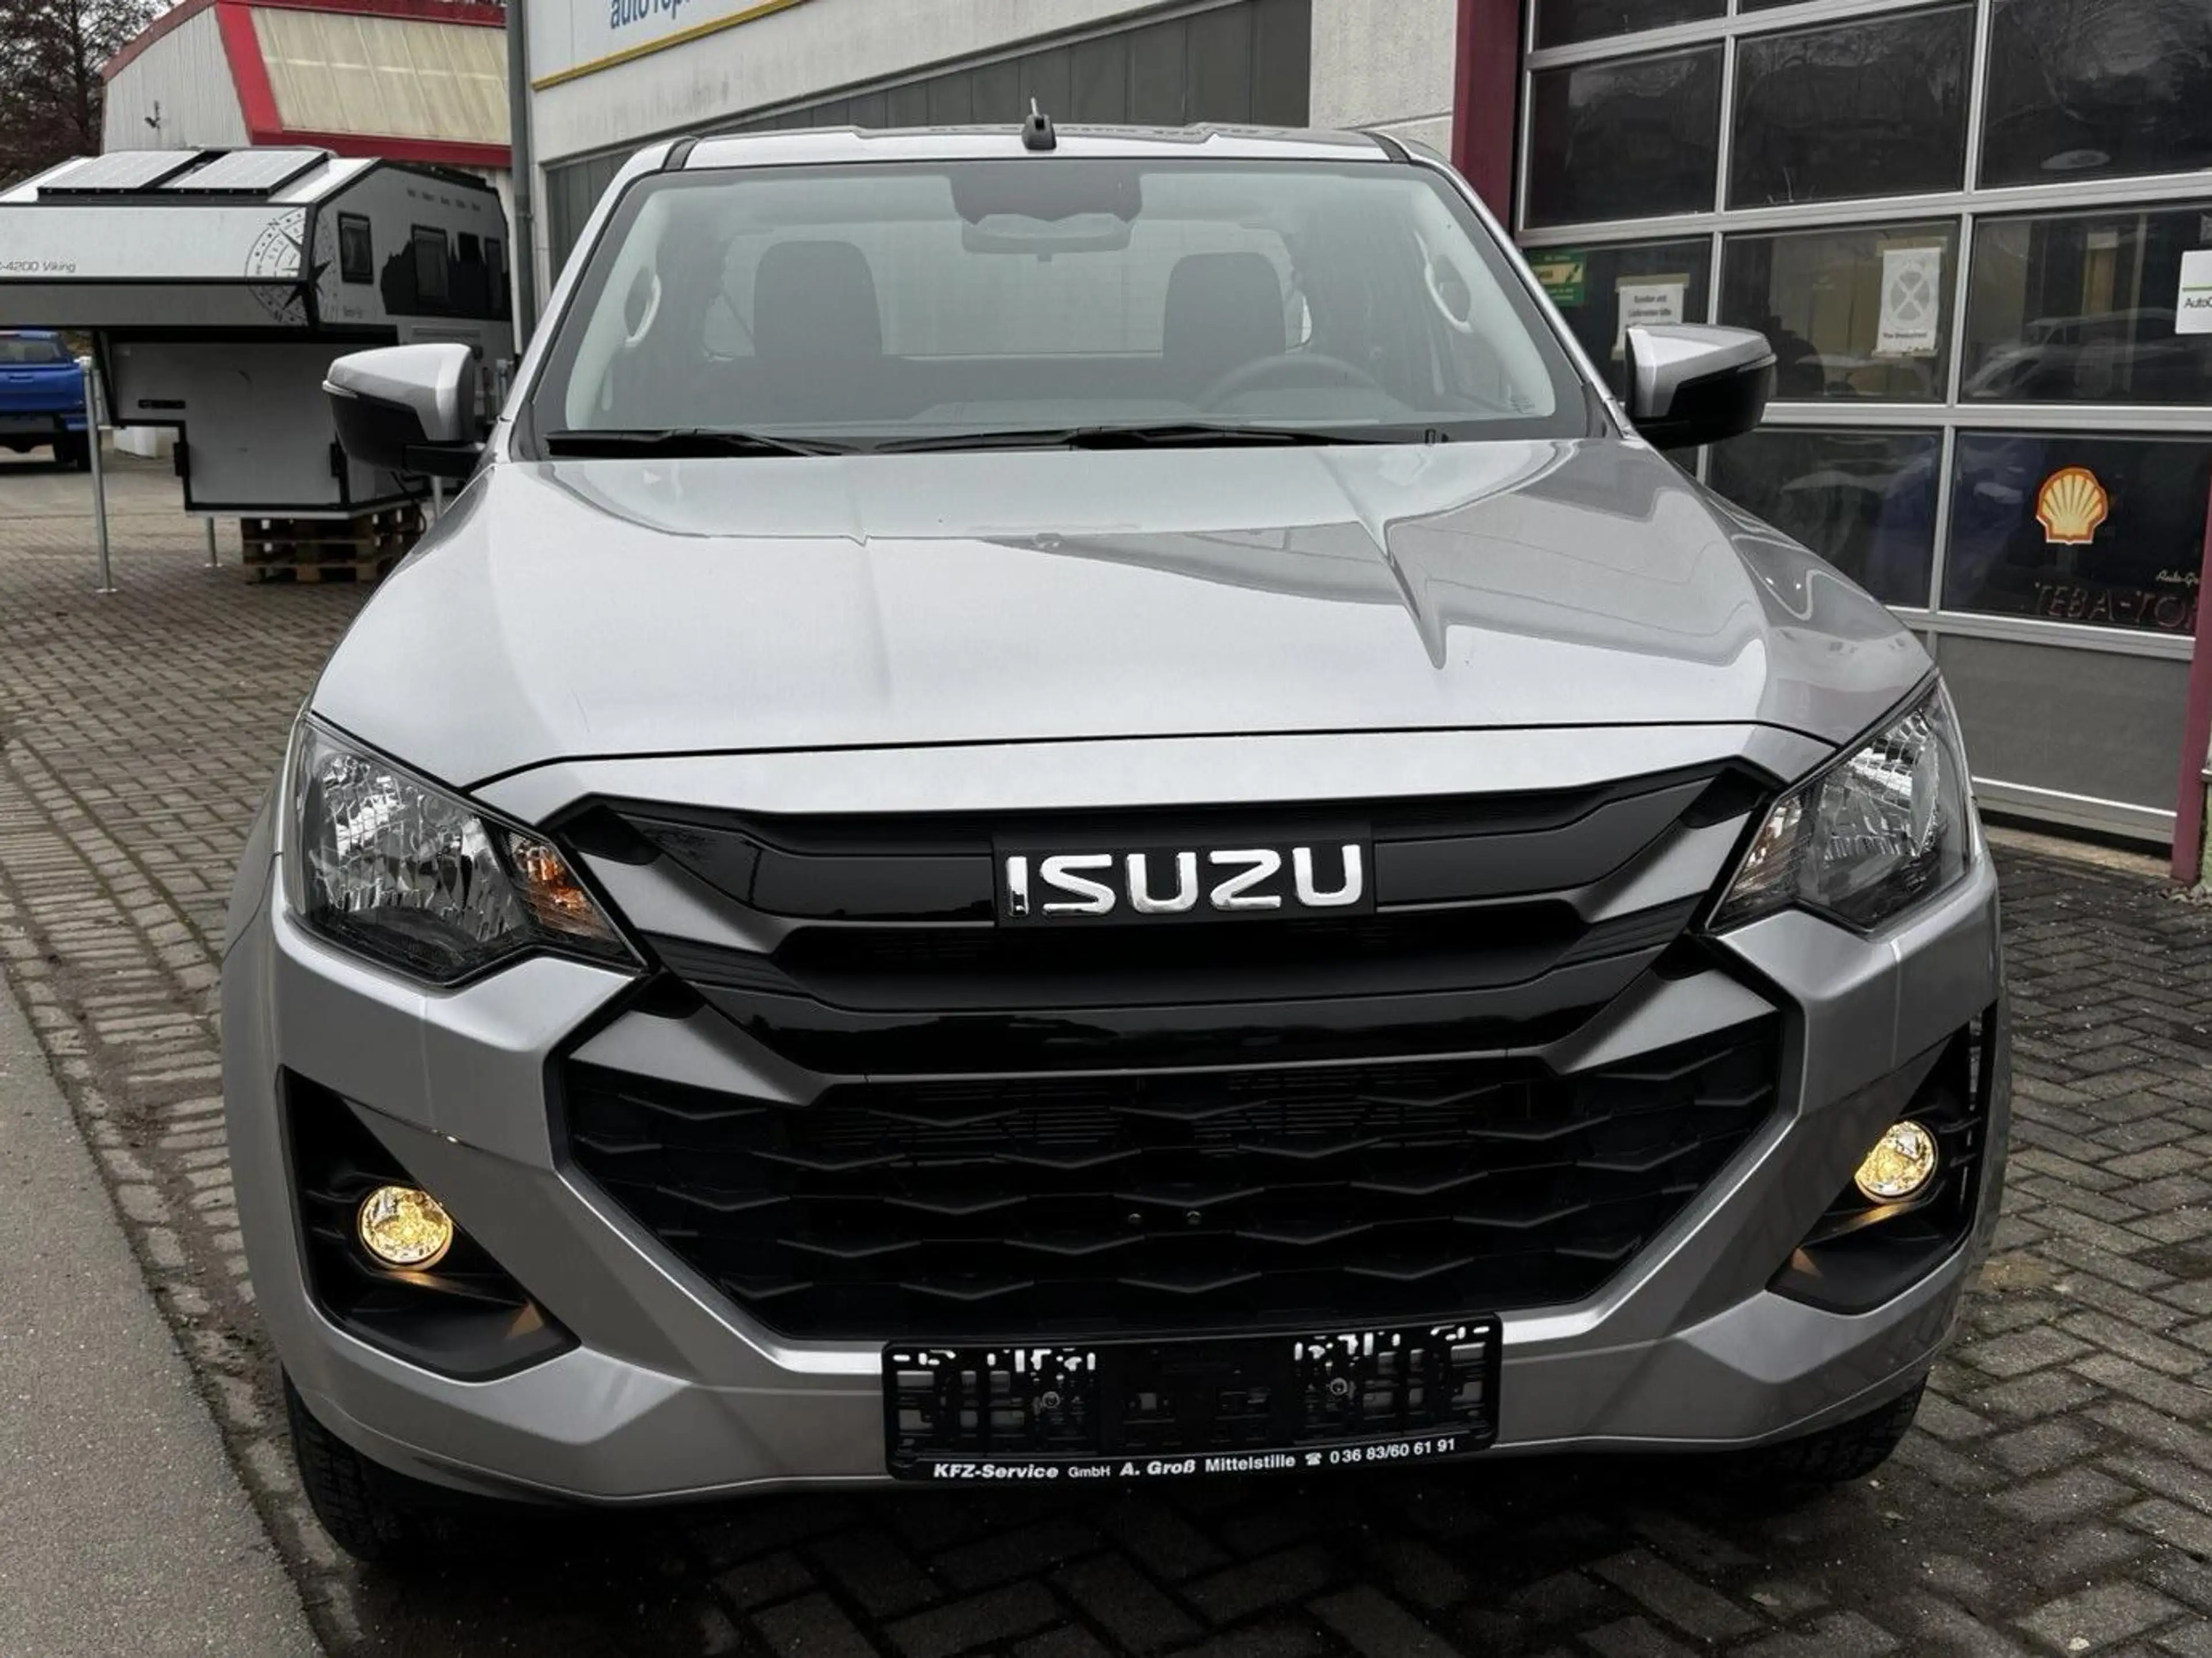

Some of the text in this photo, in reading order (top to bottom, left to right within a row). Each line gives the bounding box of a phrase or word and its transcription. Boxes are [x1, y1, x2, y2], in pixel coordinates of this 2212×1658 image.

[1006, 844, 1363, 916] ISUZU
[934, 1463, 1059, 1478] KFZ-Service
[1068, 1465, 1111, 1478] GmbH
[1119, 1462, 1141, 1476] A.
[1146, 1459, 1196, 1475] Groß
[1205, 1454, 1296, 1472] Mittelstille
[1414, 1441, 1431, 1455] 61
[1437, 1438, 1455, 1452] 91
